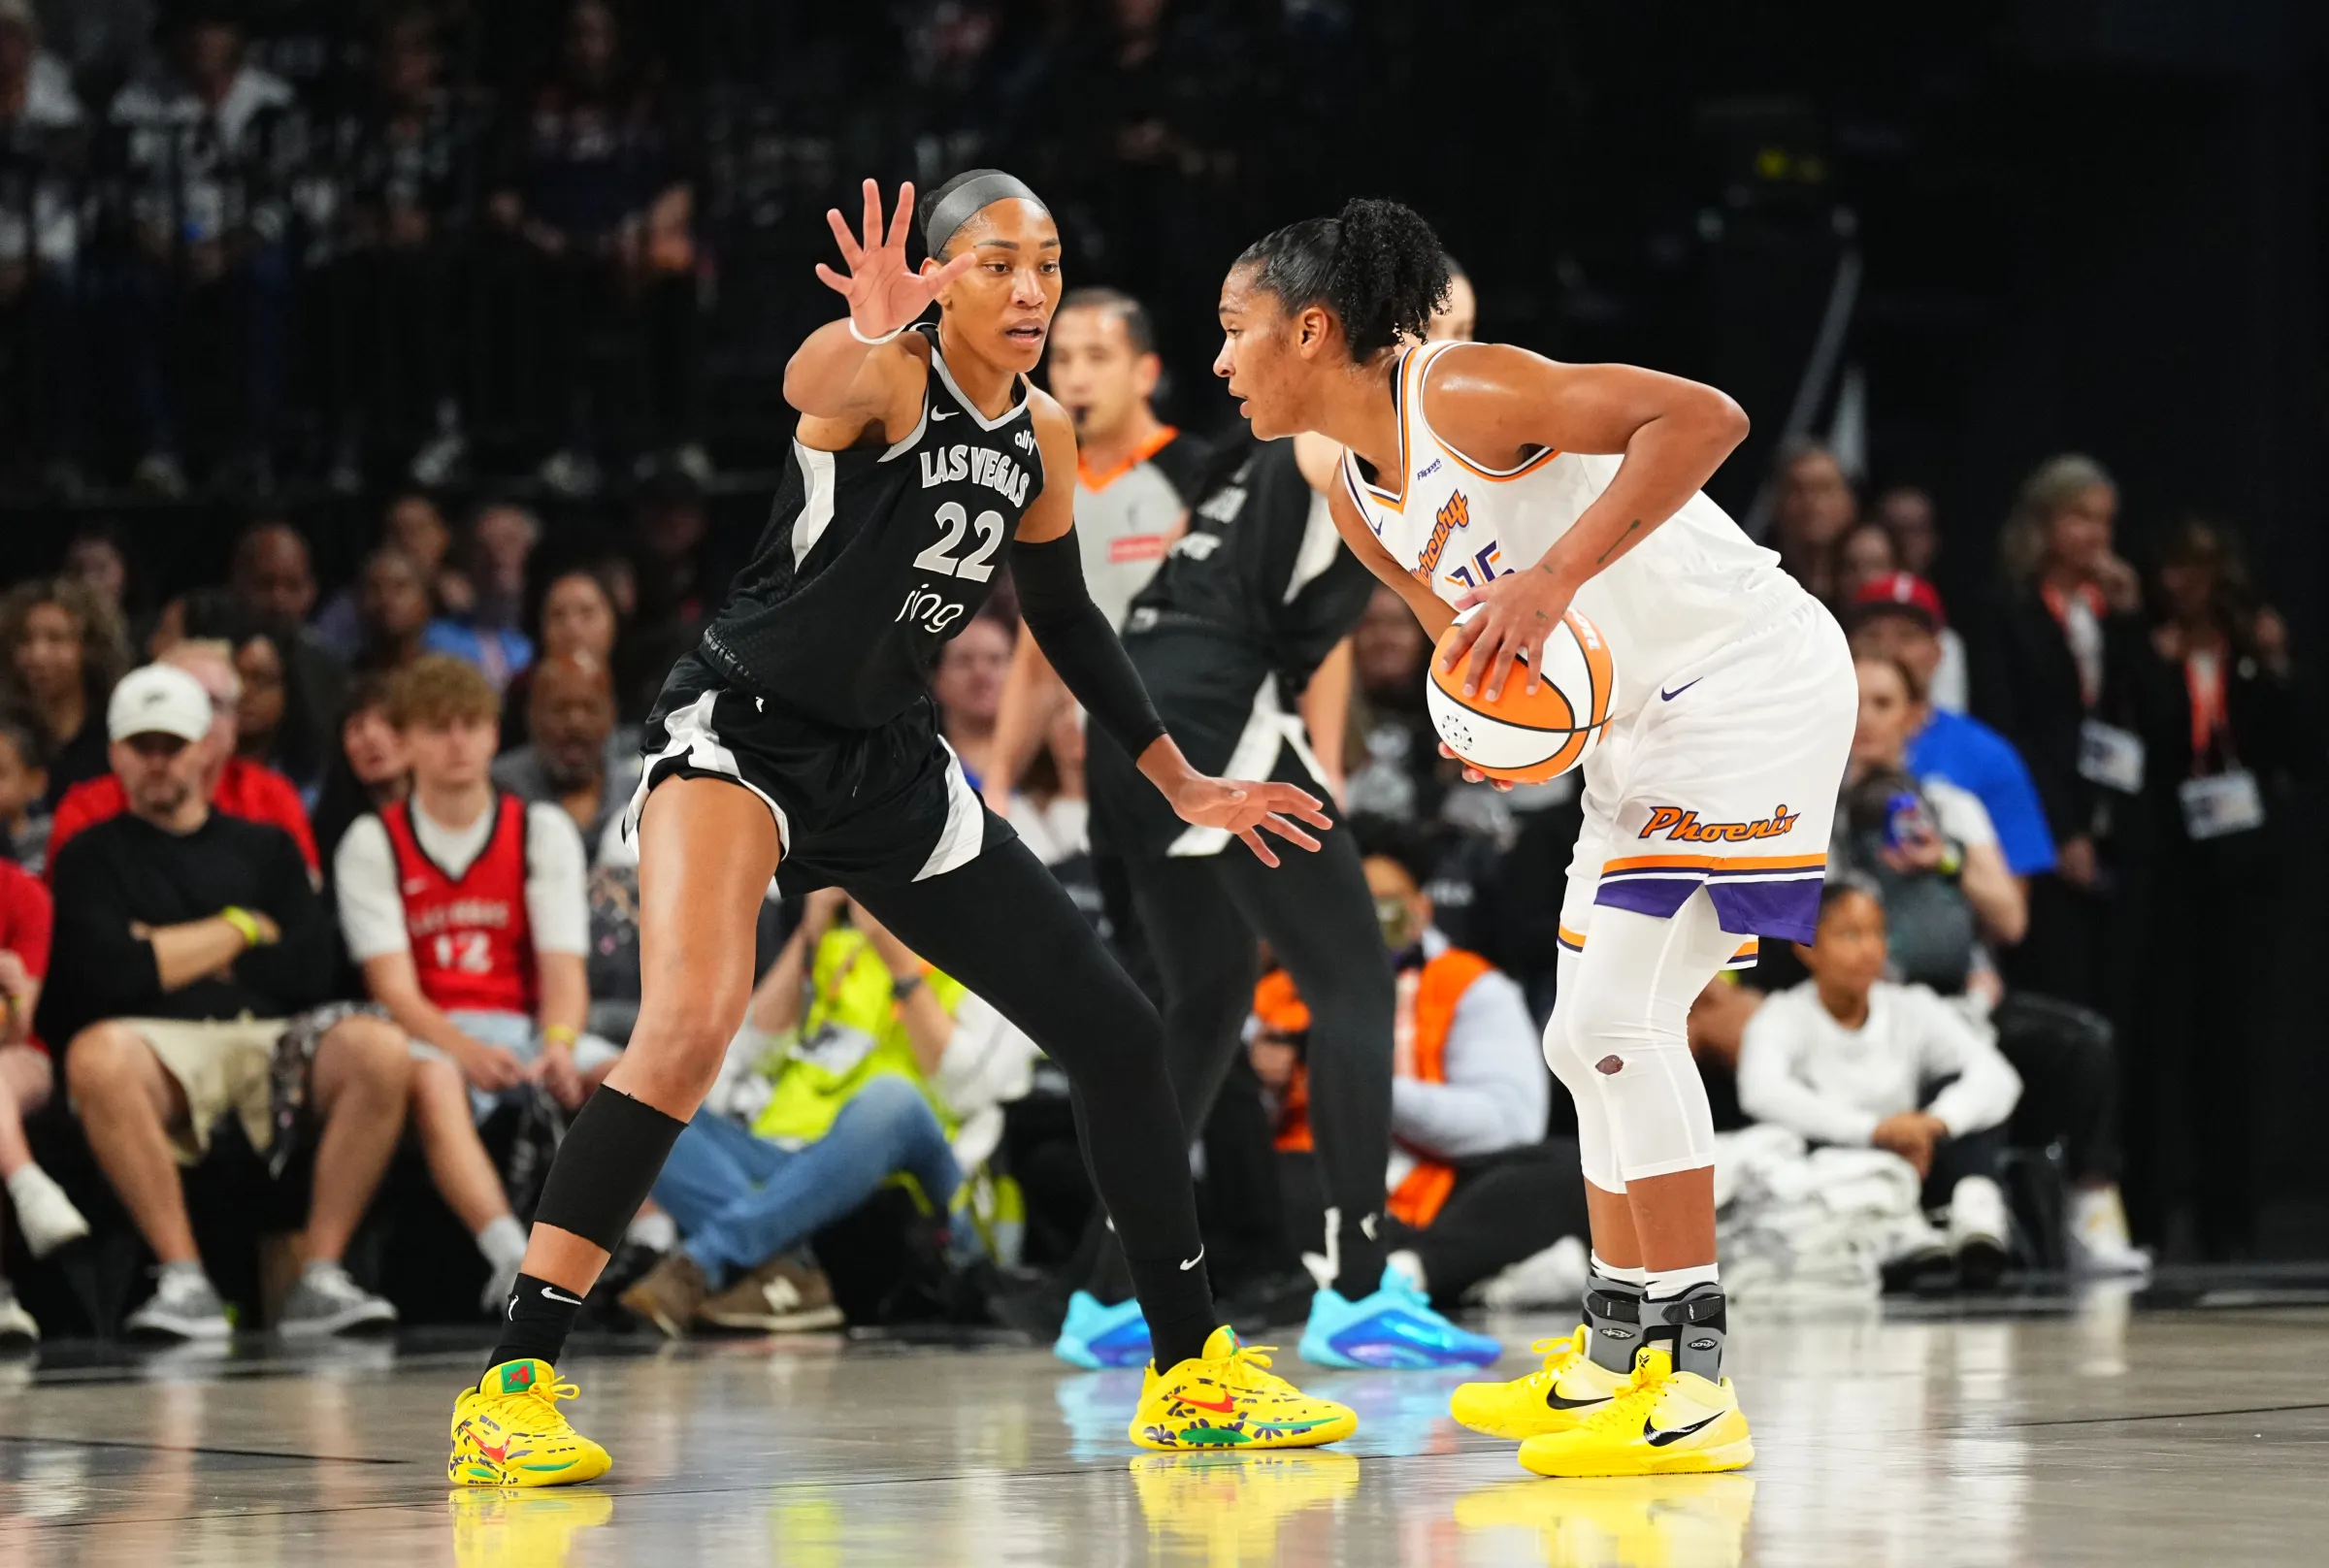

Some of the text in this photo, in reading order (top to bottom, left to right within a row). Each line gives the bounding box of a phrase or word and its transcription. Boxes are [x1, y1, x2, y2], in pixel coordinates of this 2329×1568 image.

[1014, 430, 1034, 455] ally
[920, 444, 1030, 507] LAS VEGAS
[913, 501, 1004, 582] 22
[895, 583, 964, 633] ring
[1638, 803, 1801, 843] Phoenix
